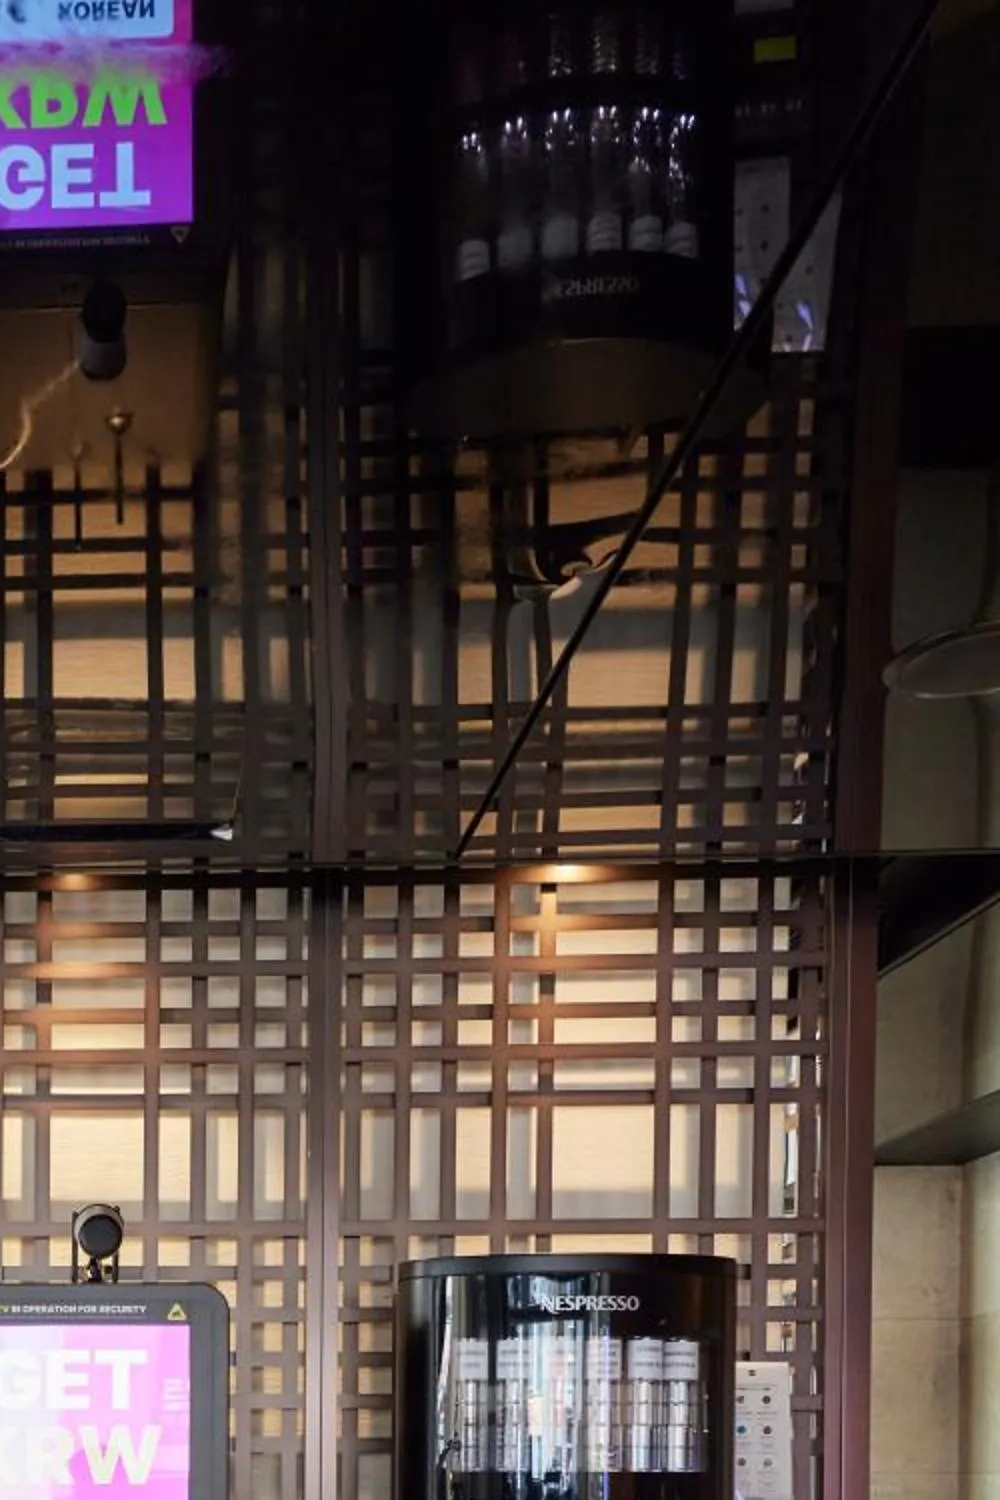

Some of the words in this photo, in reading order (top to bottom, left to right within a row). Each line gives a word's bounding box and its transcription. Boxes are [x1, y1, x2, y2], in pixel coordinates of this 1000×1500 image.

[21, 1304, 77, 1313] OPERATION
[79, 1304, 98, 1313] FOR
[99, 1304, 147, 1314] SECURITY
[540, 1295, 639, 1314] NESPRESSO
